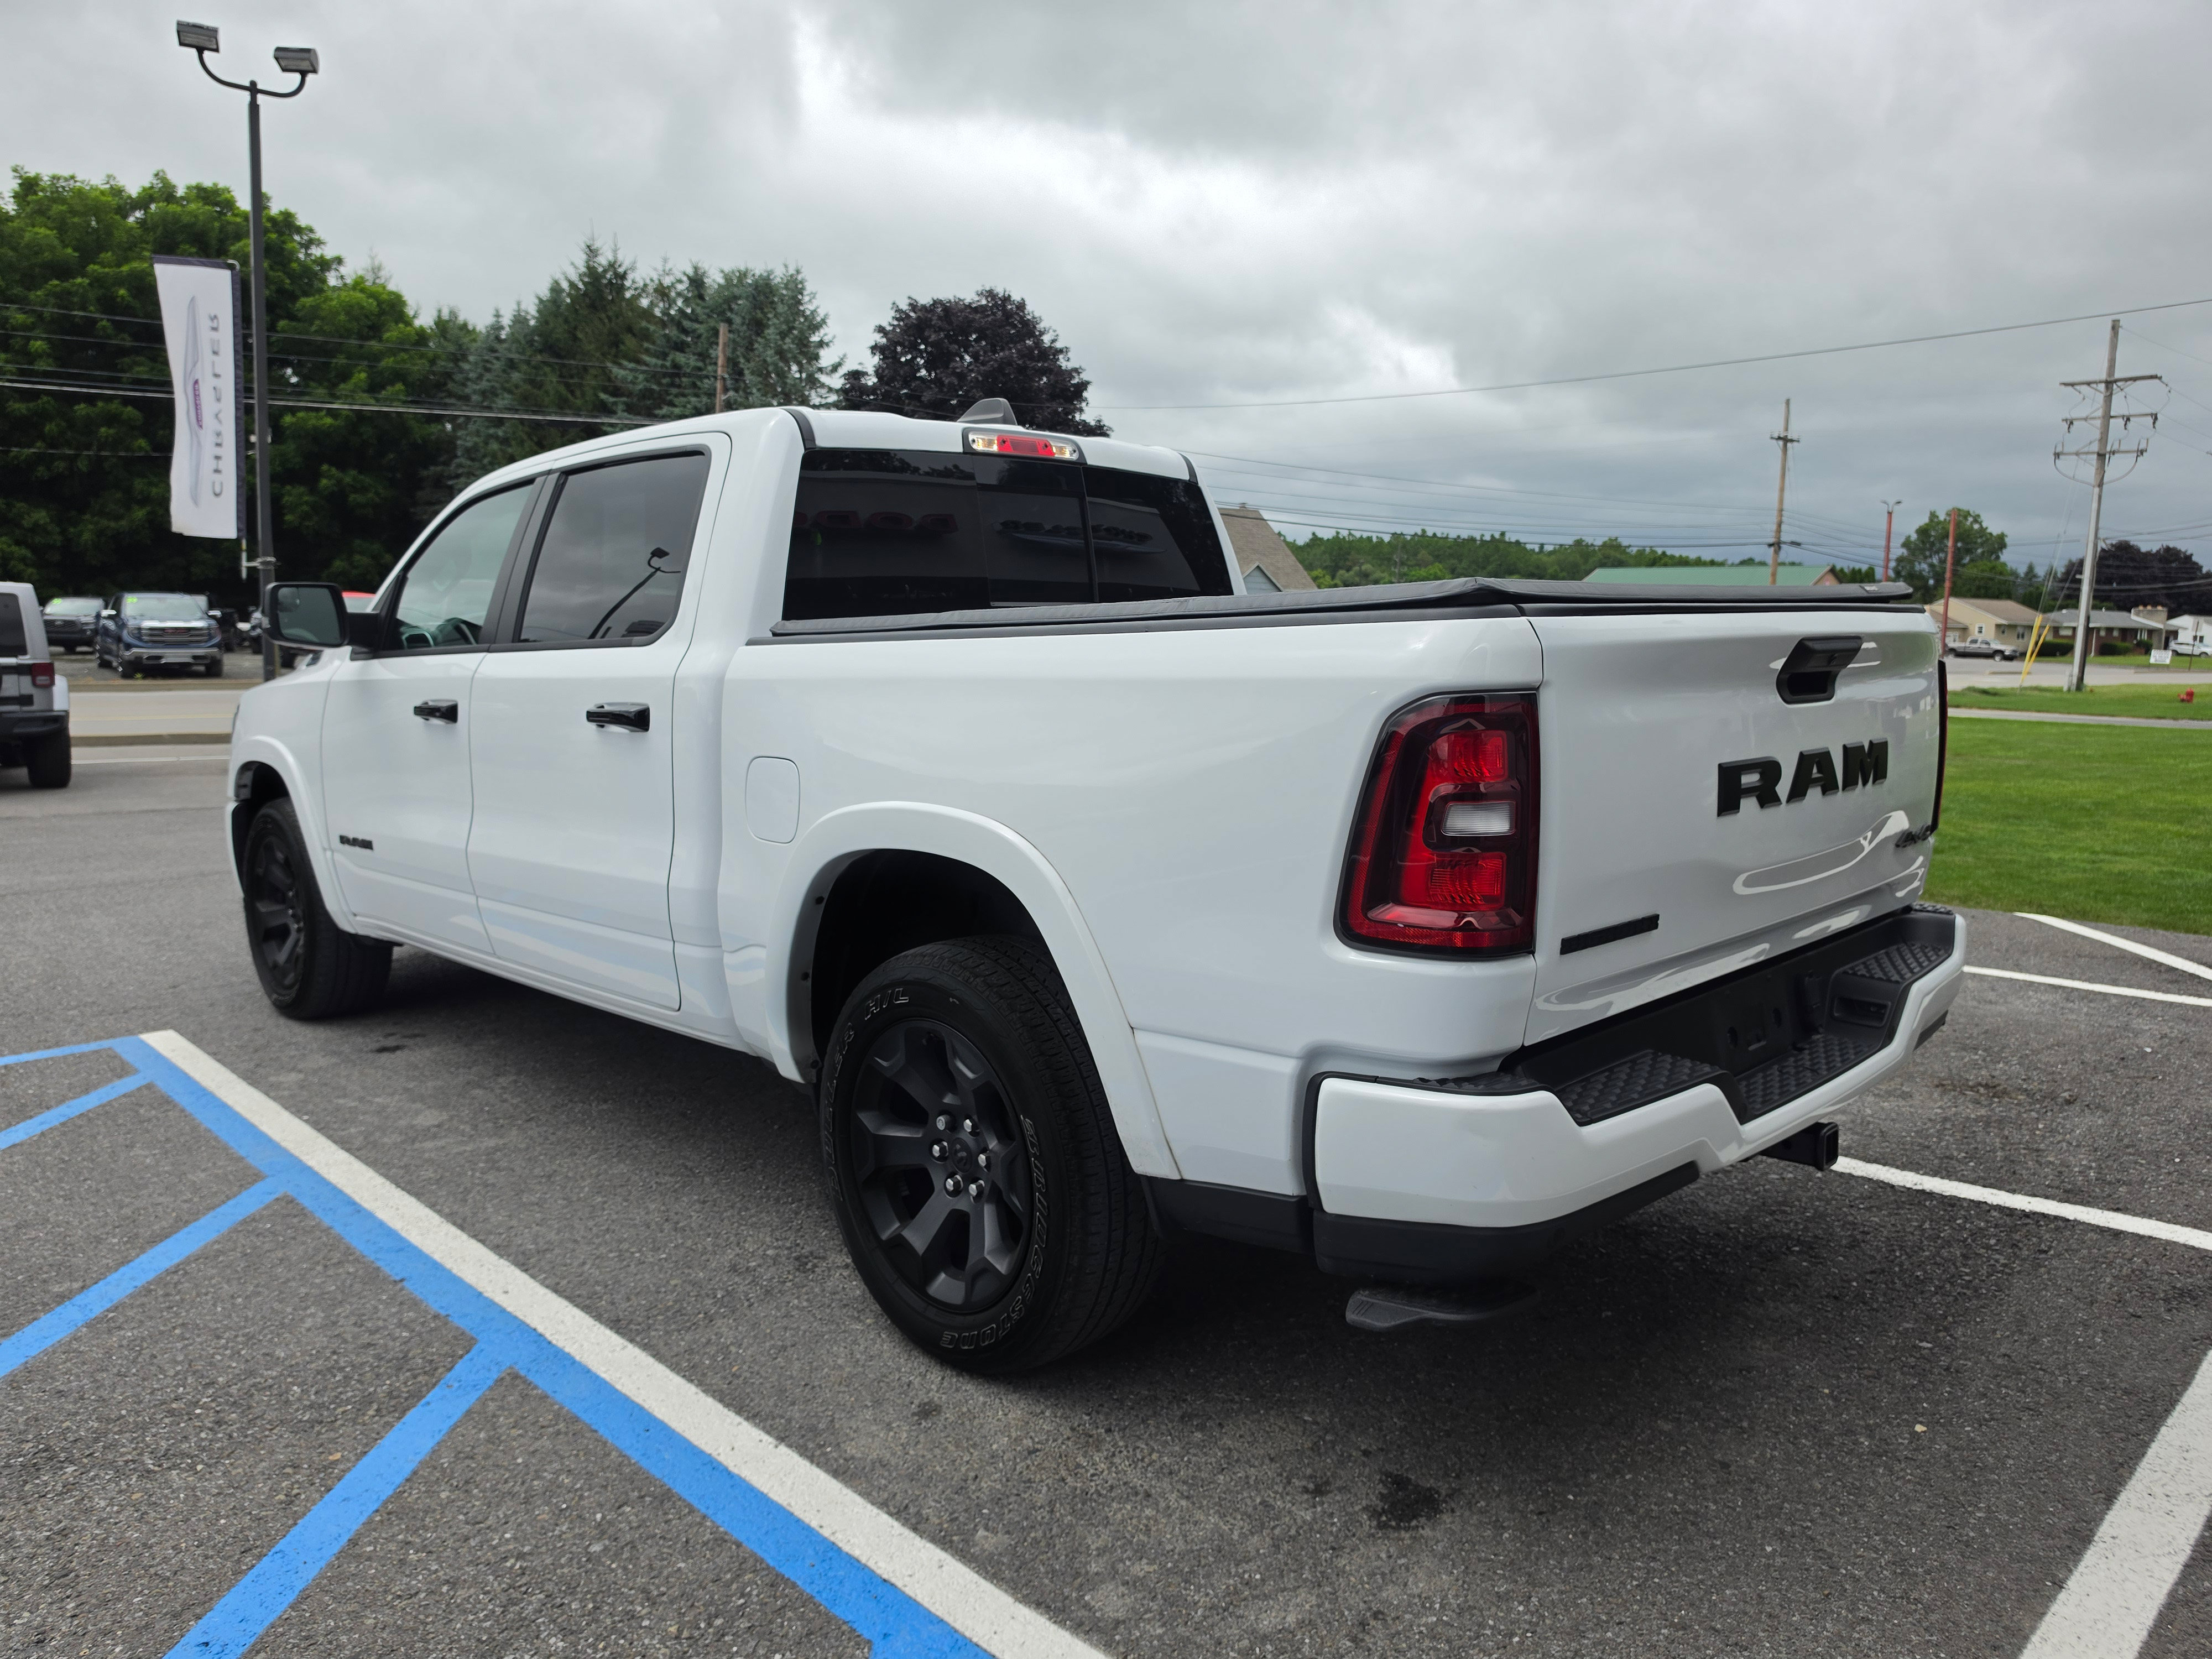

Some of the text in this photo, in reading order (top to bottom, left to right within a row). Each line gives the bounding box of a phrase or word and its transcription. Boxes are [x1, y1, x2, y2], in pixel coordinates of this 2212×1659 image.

[1717, 738, 1888, 817] RAM
[864, 987, 910, 1020] H/L
[939, 1114, 1048, 1349] BRIDGESTONE
